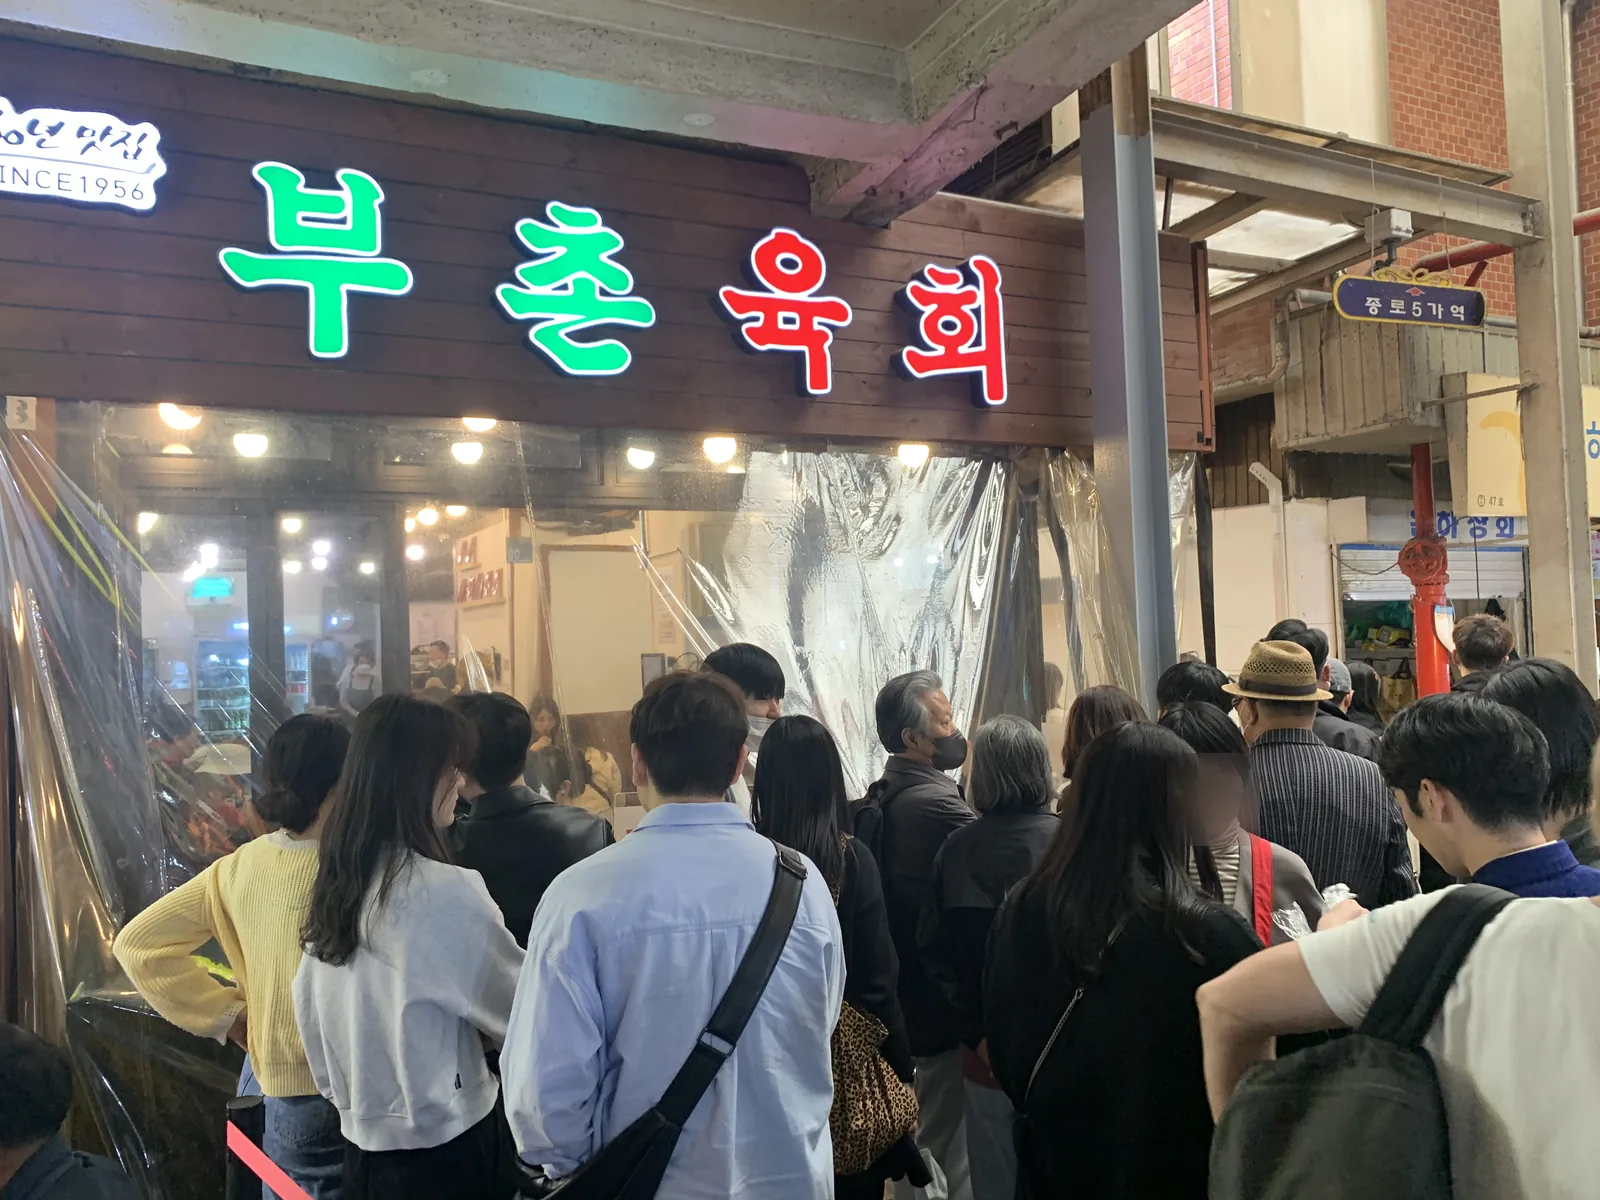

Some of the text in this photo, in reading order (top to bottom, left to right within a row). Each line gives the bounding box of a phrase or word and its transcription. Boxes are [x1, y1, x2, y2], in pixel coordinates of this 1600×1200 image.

[0, 109, 148, 160] 0년 맛집
[1364, 297, 1465, 321] 종로5가역
